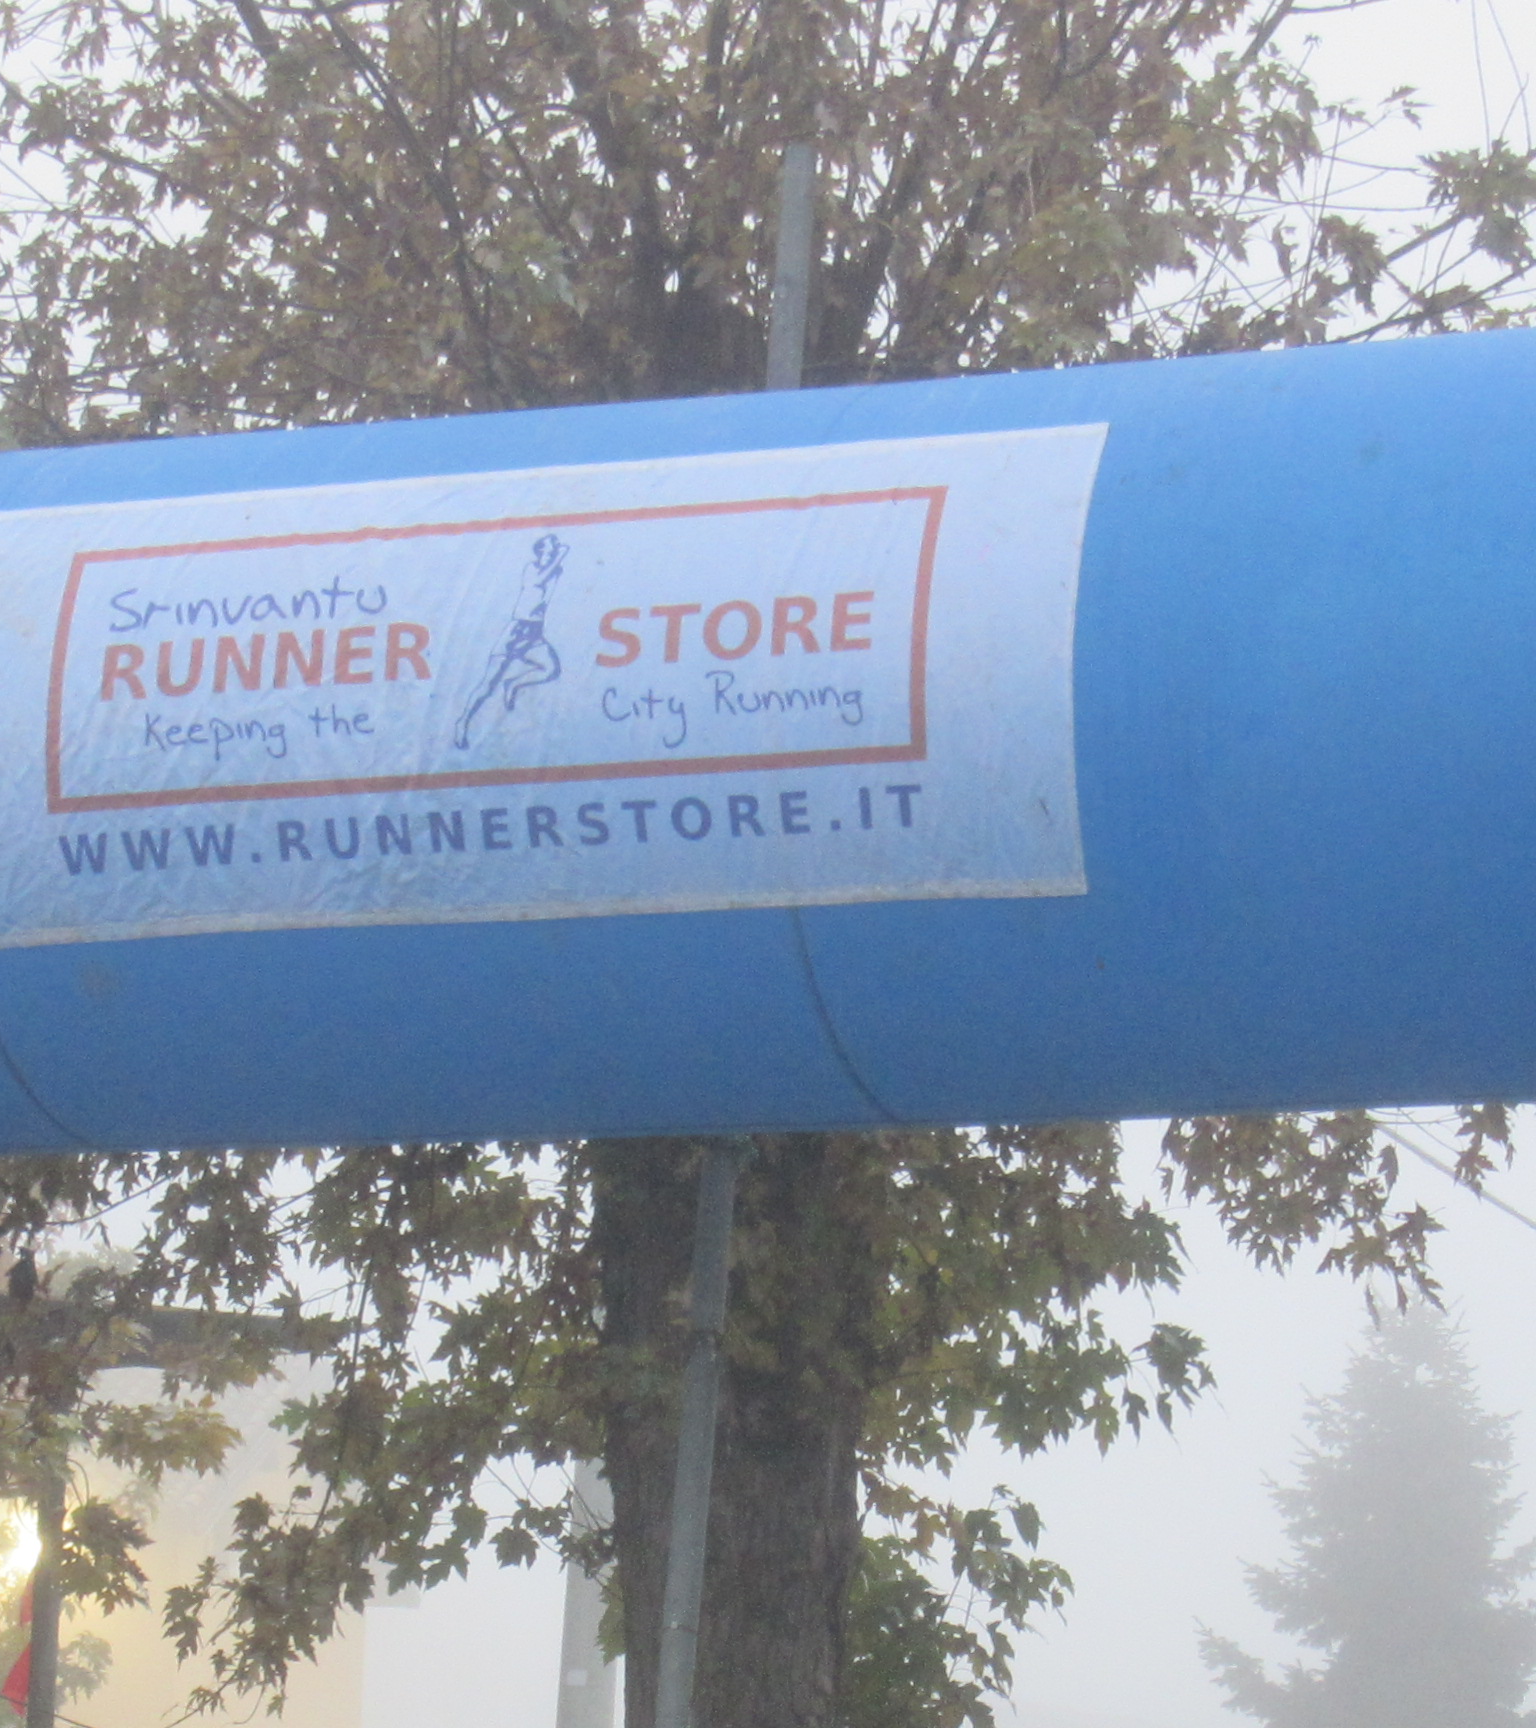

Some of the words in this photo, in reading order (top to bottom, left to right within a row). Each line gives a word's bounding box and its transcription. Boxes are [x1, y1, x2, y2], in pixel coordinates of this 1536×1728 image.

[99, 621, 433, 702] RUNNER
[594, 590, 876, 671] STORE
[309, 702, 377, 743] the
[600, 682, 690, 749] City
[704, 670, 866, 728] Running
[57, 784, 927, 878] WWW.RUNNERSTORE.IT
